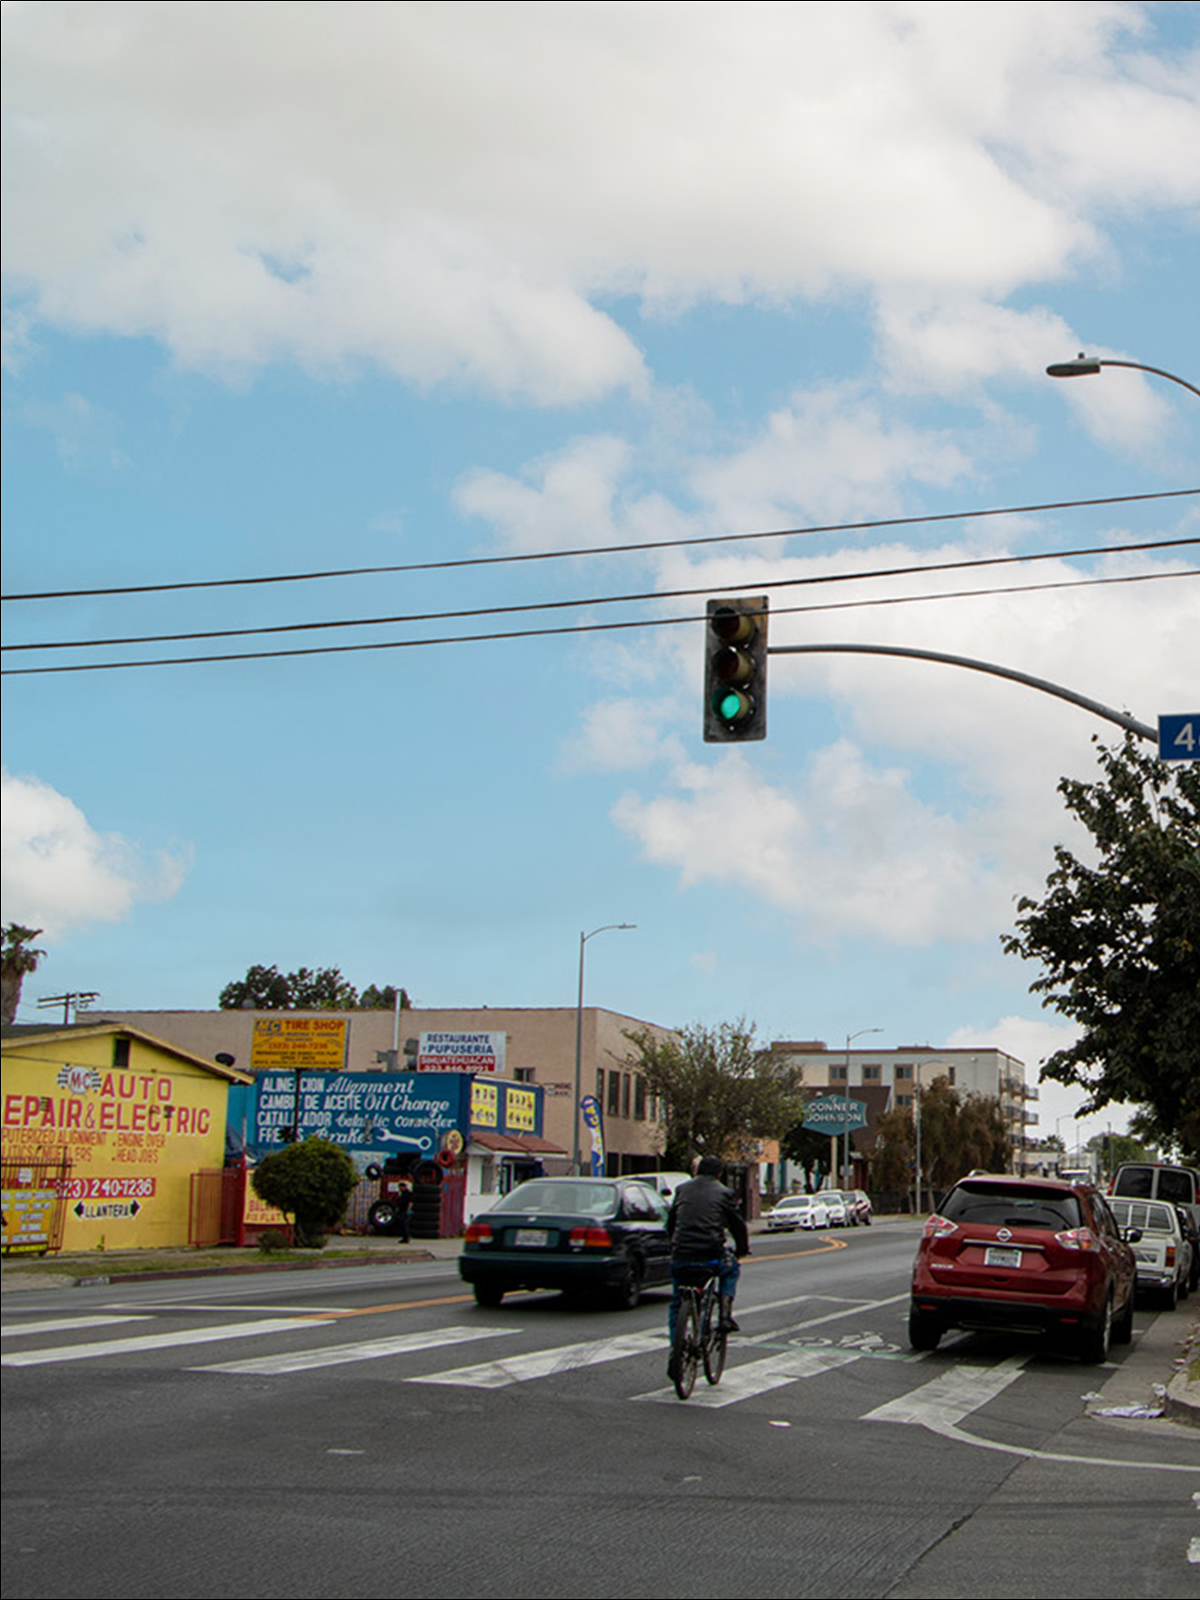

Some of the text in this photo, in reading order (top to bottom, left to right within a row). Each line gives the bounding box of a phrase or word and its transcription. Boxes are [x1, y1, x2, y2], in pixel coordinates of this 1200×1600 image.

[285, 1021, 310, 1031] TIRE
[313, 1021, 344, 1031] SHOP
[427, 1033, 490, 1043] RESTAURANTE
[428, 1045, 494, 1054] PUPUSERIA
[100, 1073, 173, 1102] AUTO
[262, 1076, 415, 1097] ALINECION Alignment
[259, 1093, 450, 1118] CAMBI DE ACEITE Oil Change
[808, 1102, 858, 1112] CONNER
[2, 1094, 210, 1136] EPAIR & ELECTRIC
[806, 1113, 862, 1122] JOHNSON
[258, 1127, 304, 1143] FRES
[91, 1178, 153, 1198] 240-7236
[84, 1204, 129, 1218] LLANTERA
